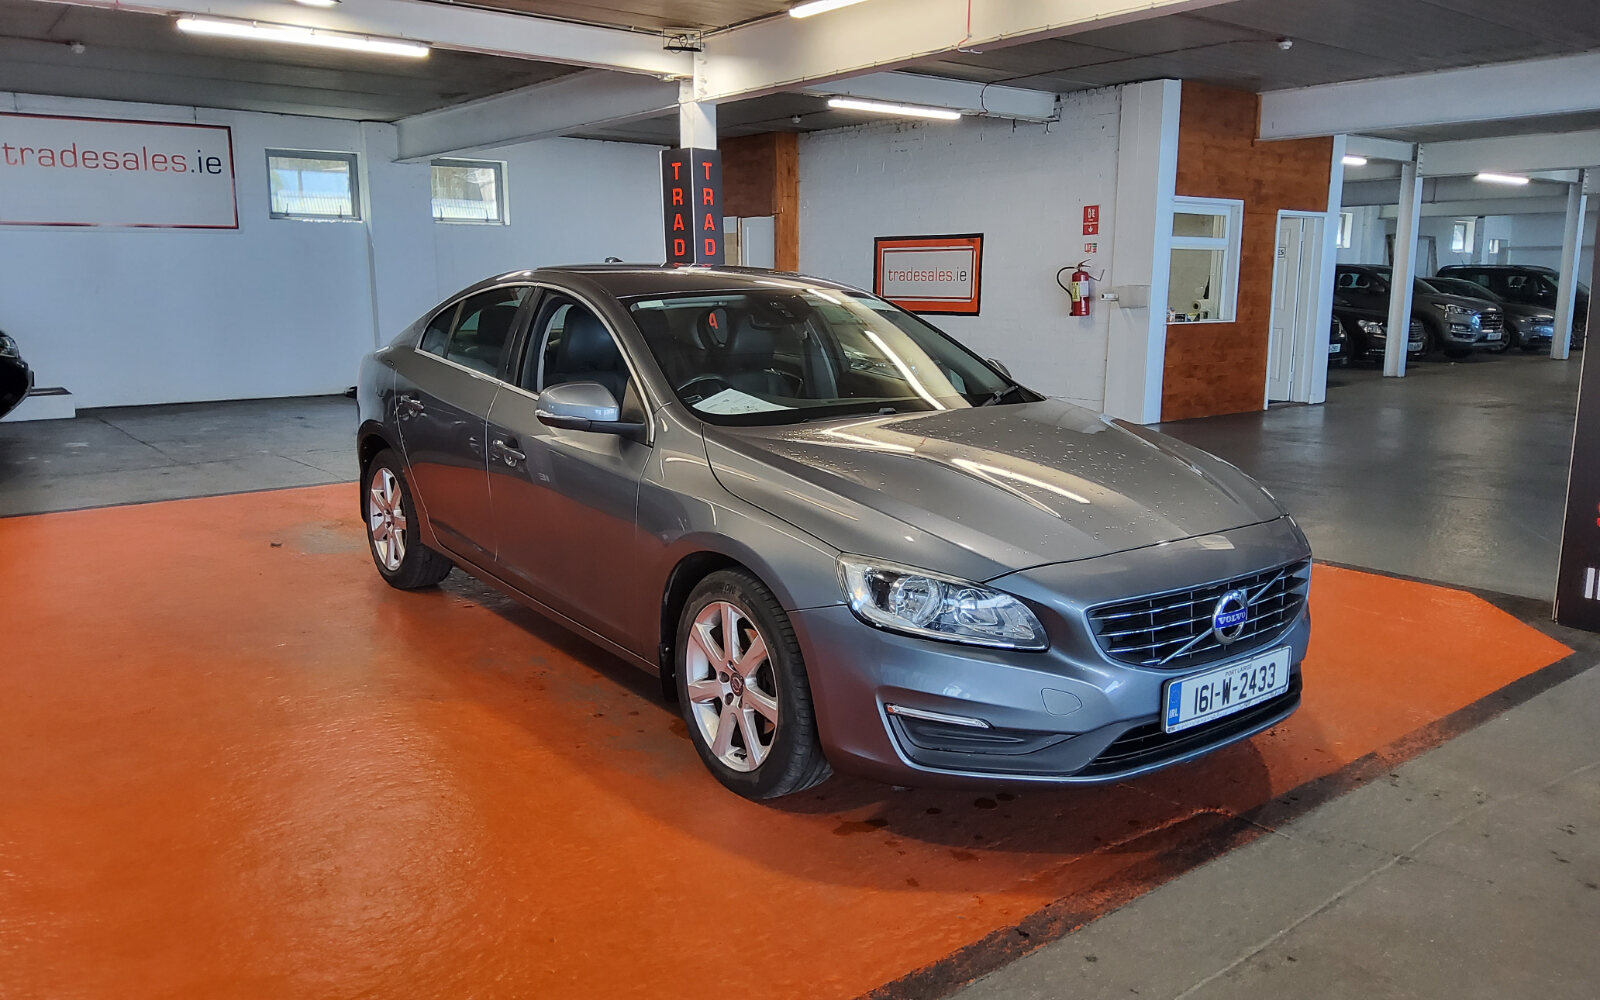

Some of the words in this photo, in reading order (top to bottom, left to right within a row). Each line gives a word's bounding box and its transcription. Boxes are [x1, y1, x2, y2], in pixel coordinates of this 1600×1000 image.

[2, 142, 222, 174] tradesales.ie
[671, 162, 686, 268] TRAD
[702, 162, 716, 268] TRAD
[888, 266, 967, 282] tradesales.ie
[1218, 611, 1246, 625] VOLVO
[1194, 661, 1276, 716] 161-W-2433
